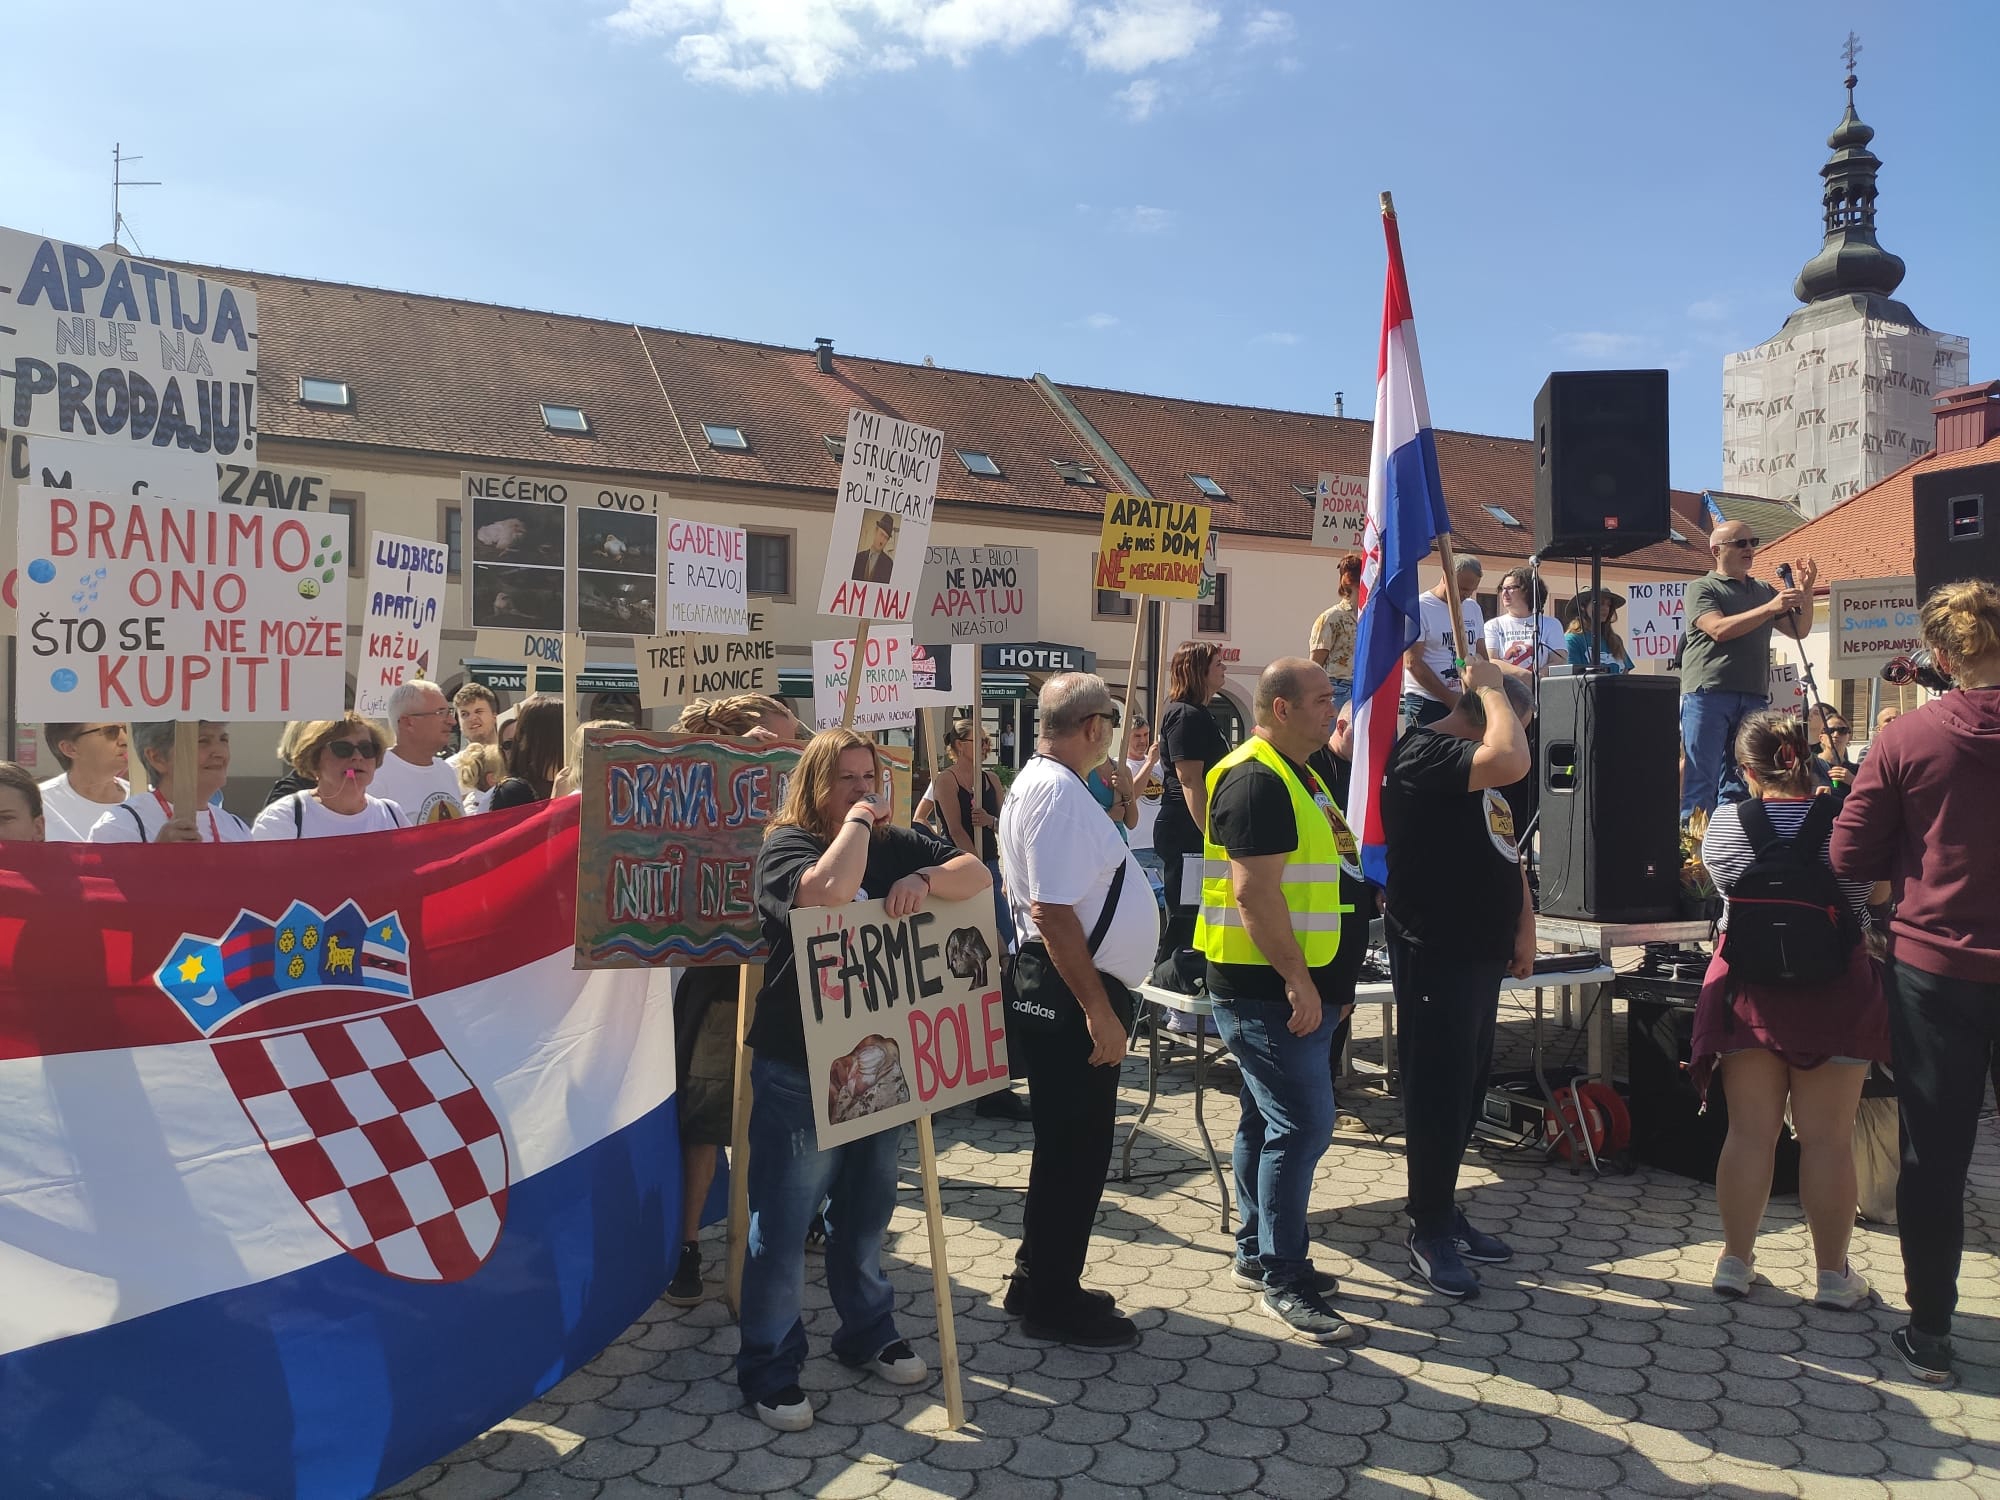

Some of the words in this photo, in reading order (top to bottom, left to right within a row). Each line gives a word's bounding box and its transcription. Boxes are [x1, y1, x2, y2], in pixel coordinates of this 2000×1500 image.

[17, 240, 249, 351] APATIJA
[56, 316, 138, 361] NIJE
[159, 332, 213, 376] NA
[1767, 337, 1795, 361] ATK
[1797, 348, 1826, 369] ATK
[1933, 350, 1953, 368] ATK
[1828, 360, 1859, 381] ATK
[1885, 370, 1908, 388] ATK
[1862, 374, 1884, 394] ATK
[1910, 376, 1931, 395] ATK
[14, 357, 253, 455] PRODAJU!
[1738, 401, 1765, 418] ATK
[1767, 395, 1794, 418] ATK
[1796, 408, 1826, 428] ATK
[892, 422, 941, 459] NISMO
[1828, 420, 1859, 441] ATK
[1885, 429, 1906, 448] ATK
[1862, 433, 1884, 454] ATK
[1739, 458, 1766, 475] ATK
[1768, 453, 1796, 475] ATK
[216, 463, 323, 511] ZAVE
[866, 472, 876, 482] MI
[885, 475, 904, 487] SMO
[1798, 468, 1827, 487] ATK
[467, 476, 568, 504] NEĆEMO
[597, 490, 645, 512] OVO
[1831, 480, 1859, 500] ATK
[1110, 498, 1197, 534] APATIJA
[1322, 515, 1338, 528] ZA
[50, 499, 311, 573] BRANIMO
[1117, 532, 1133, 550] je
[1135, 533, 1155, 551] naš
[376, 540, 444, 574] LUDBREG
[970, 548, 984, 564] JE
[687, 563, 742, 594] RAZVOJ
[946, 568, 966, 589] NE
[972, 567, 1017, 589] DAMO
[1097, 548, 1131, 589] NE
[130, 568, 247, 613] ONO
[830, 580, 868, 617] AM
[873, 587, 911, 620] NAJ
[1629, 585, 1653, 599] TKO
[931, 589, 1023, 617] APATIJU
[1843, 598, 1914, 612] PROFITERU
[672, 603, 748, 625] MEGAFARMAMA
[1843, 616, 1888, 631] SVIMA
[32, 611, 106, 656] ŠTO
[119, 616, 165, 651] SE
[204, 619, 246, 653] NE
[261, 616, 343, 656] MOŽE
[1644, 619, 1656, 633] A
[369, 632, 419, 661] KAŽU
[726, 640, 775, 662] FARME
[1000, 648, 1074, 669] HOTEL
[98, 655, 290, 712] KUPITI
[381, 666, 405, 687] NE
[488, 676, 520, 687] PAN
[866, 668, 908, 683] PRIRODA
[870, 684, 899, 703] DOM
[817, 719, 827, 730] NE
[608, 762, 719, 829] DRAVA
[724, 767, 770, 827] SE
[700, 860, 755, 917] NE
[807, 911, 943, 1024] FARME
[1012, 1001, 1056, 1019] adidas
[908, 990, 1008, 1102] BOLE
